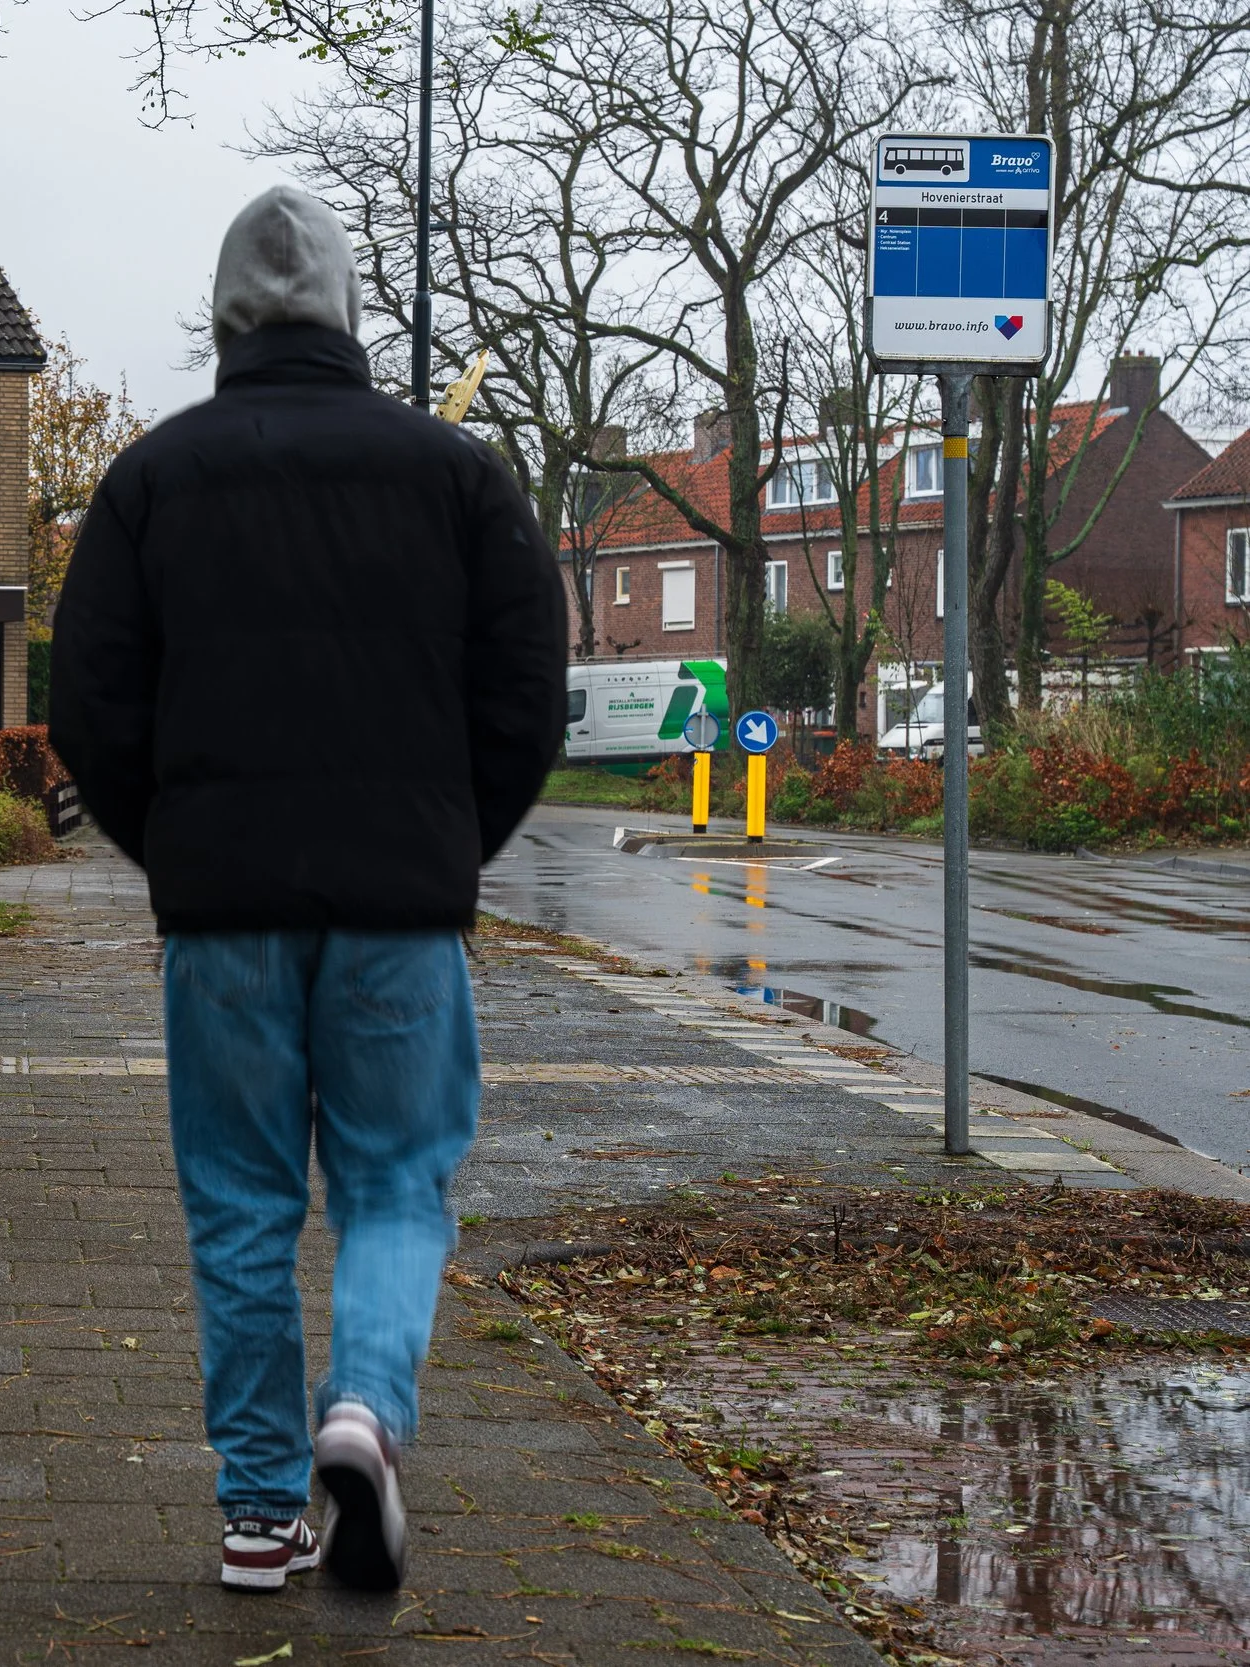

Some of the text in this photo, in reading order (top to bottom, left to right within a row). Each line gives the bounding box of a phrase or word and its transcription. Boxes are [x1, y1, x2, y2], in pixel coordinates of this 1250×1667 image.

[991, 154, 1033, 166] Bravo
[921, 192, 1004, 204] Hovenierstraat
[878, 210, 889, 223] 4
[894, 320, 989, 333] www.bravo.info
[608, 702, 655, 711] RIJSBERGEN
[239, 1521, 261, 1532] NIKE
